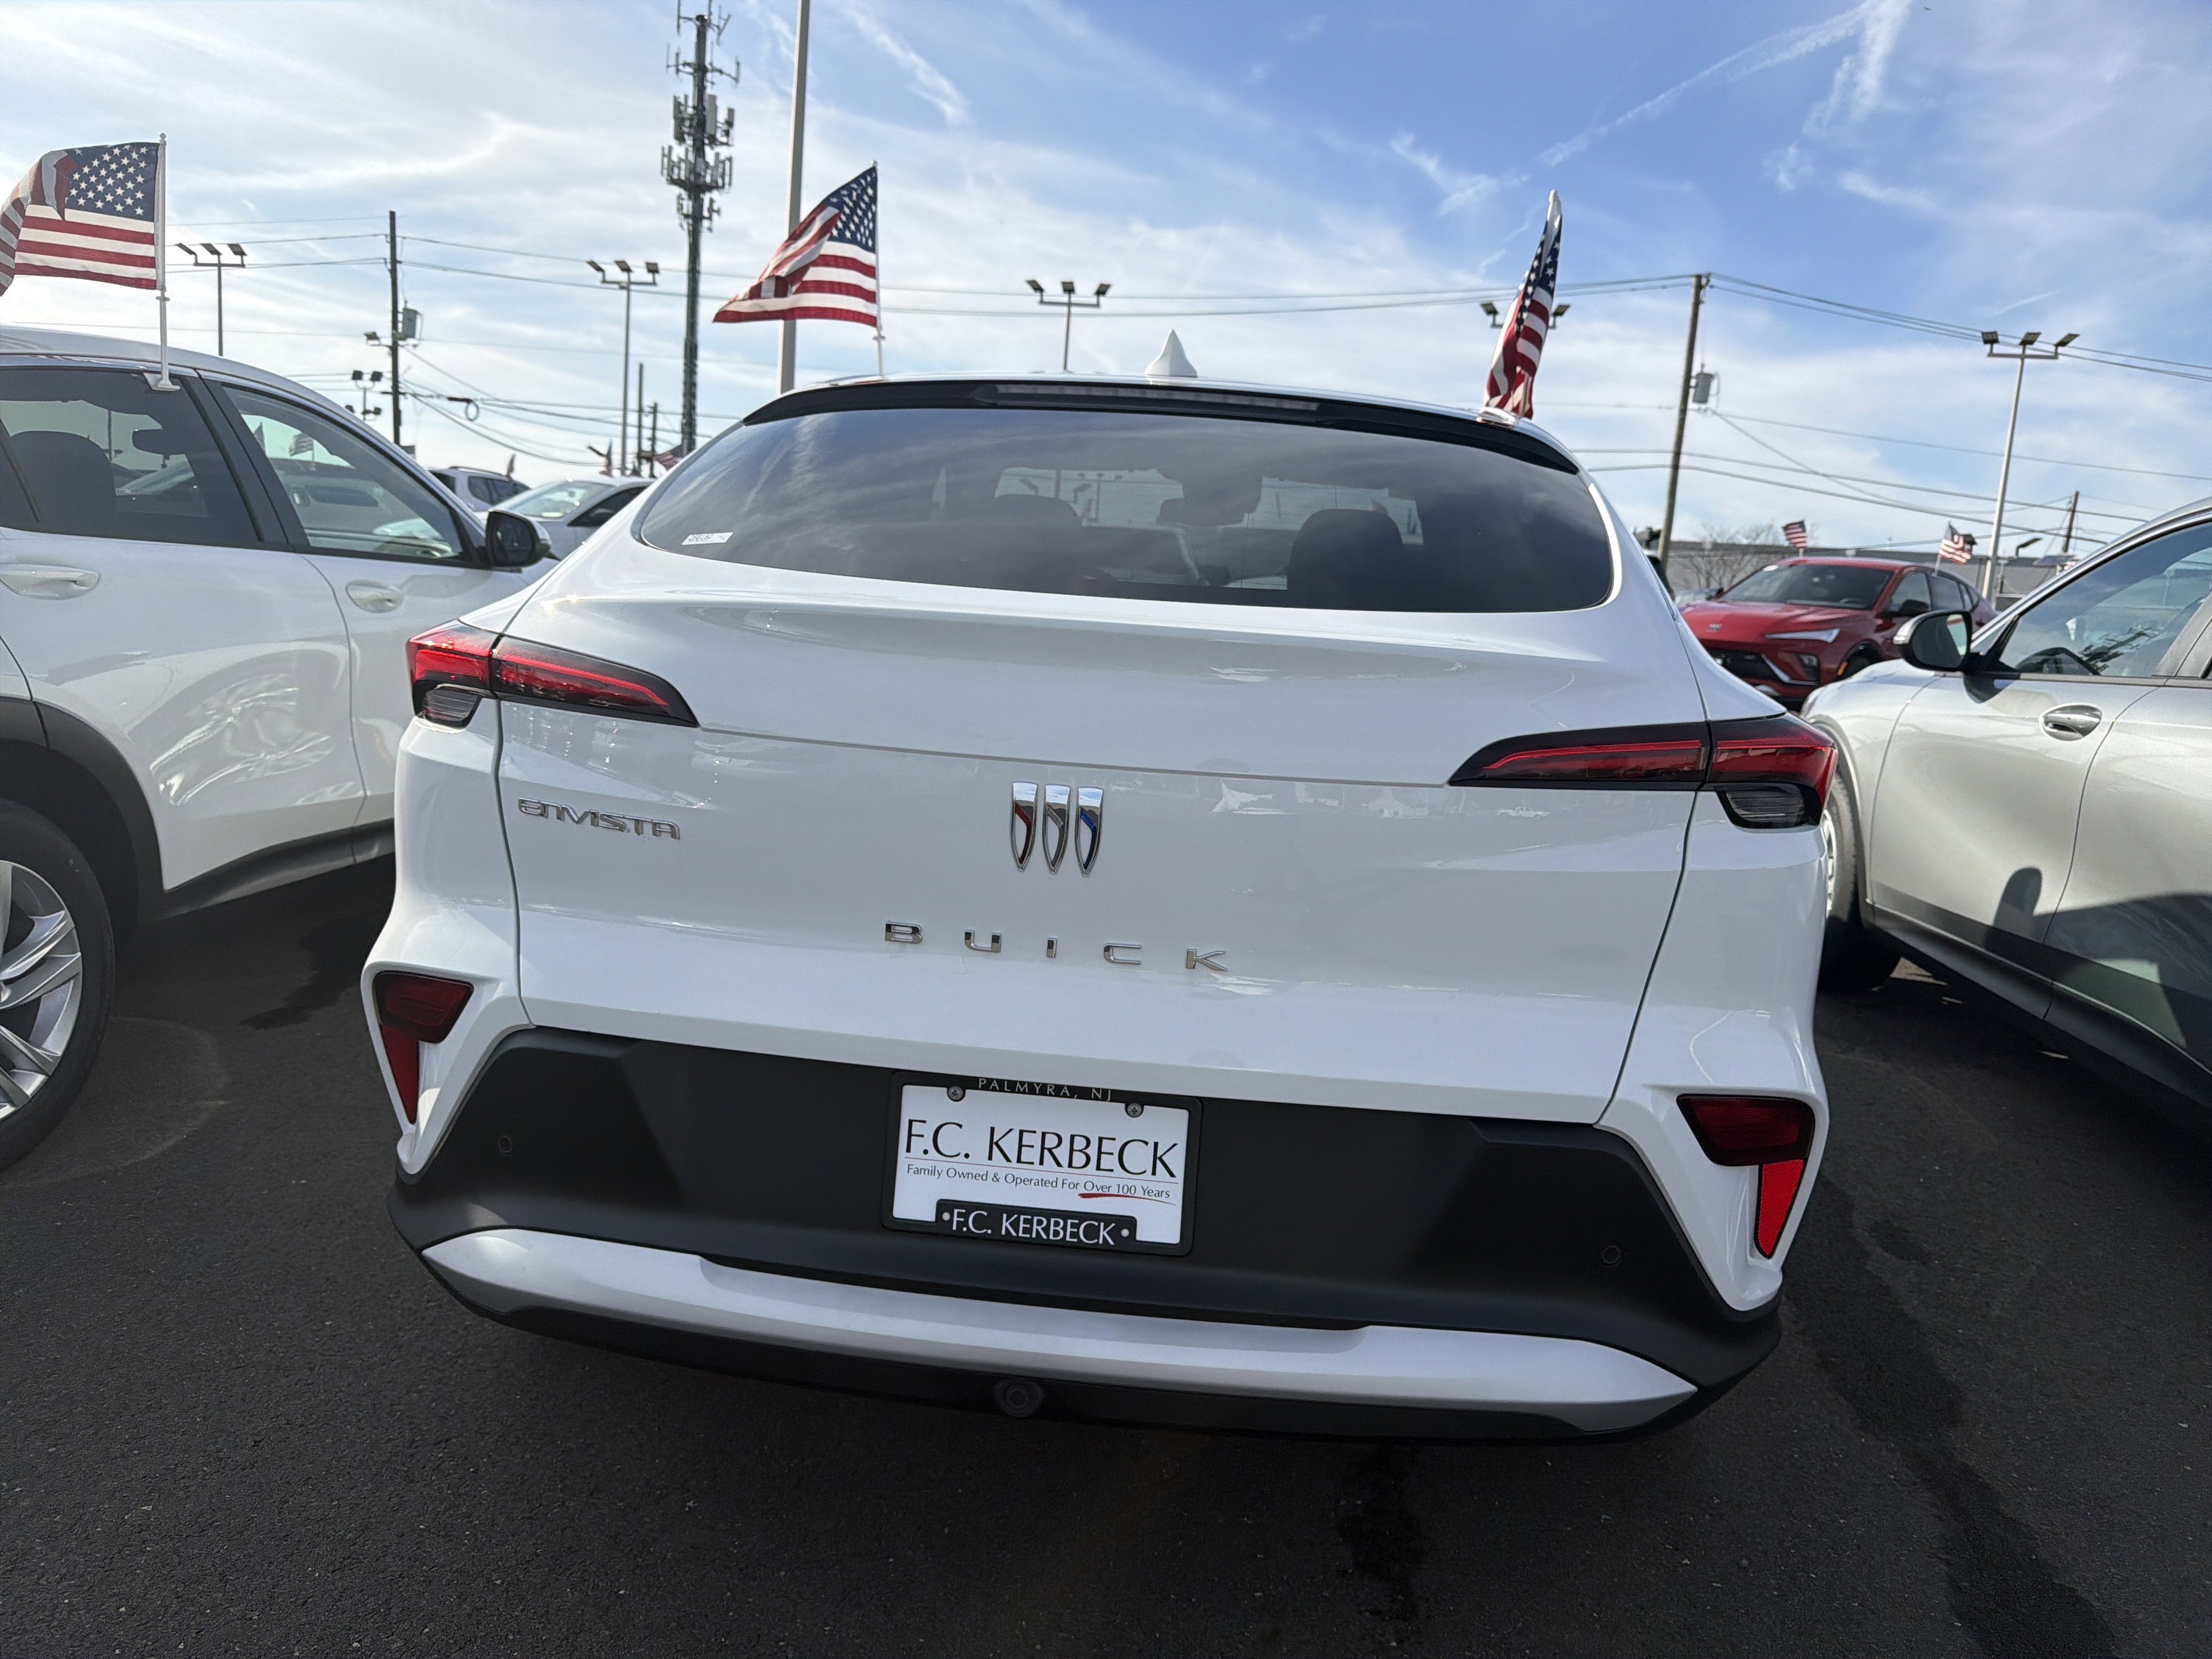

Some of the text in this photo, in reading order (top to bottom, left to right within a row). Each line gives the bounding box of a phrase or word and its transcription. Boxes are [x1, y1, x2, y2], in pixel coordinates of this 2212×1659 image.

[885, 921, 1228, 972] BUICK
[978, 1078, 1112, 1102] PALMYRA, NJ
[905, 1119, 1178, 1178] F.C. KERBECK
[907, 1164, 1170, 1199] Family Owned & Operated For Over 100 Years
[952, 1208, 1115, 1245] F.C. KERBECK
